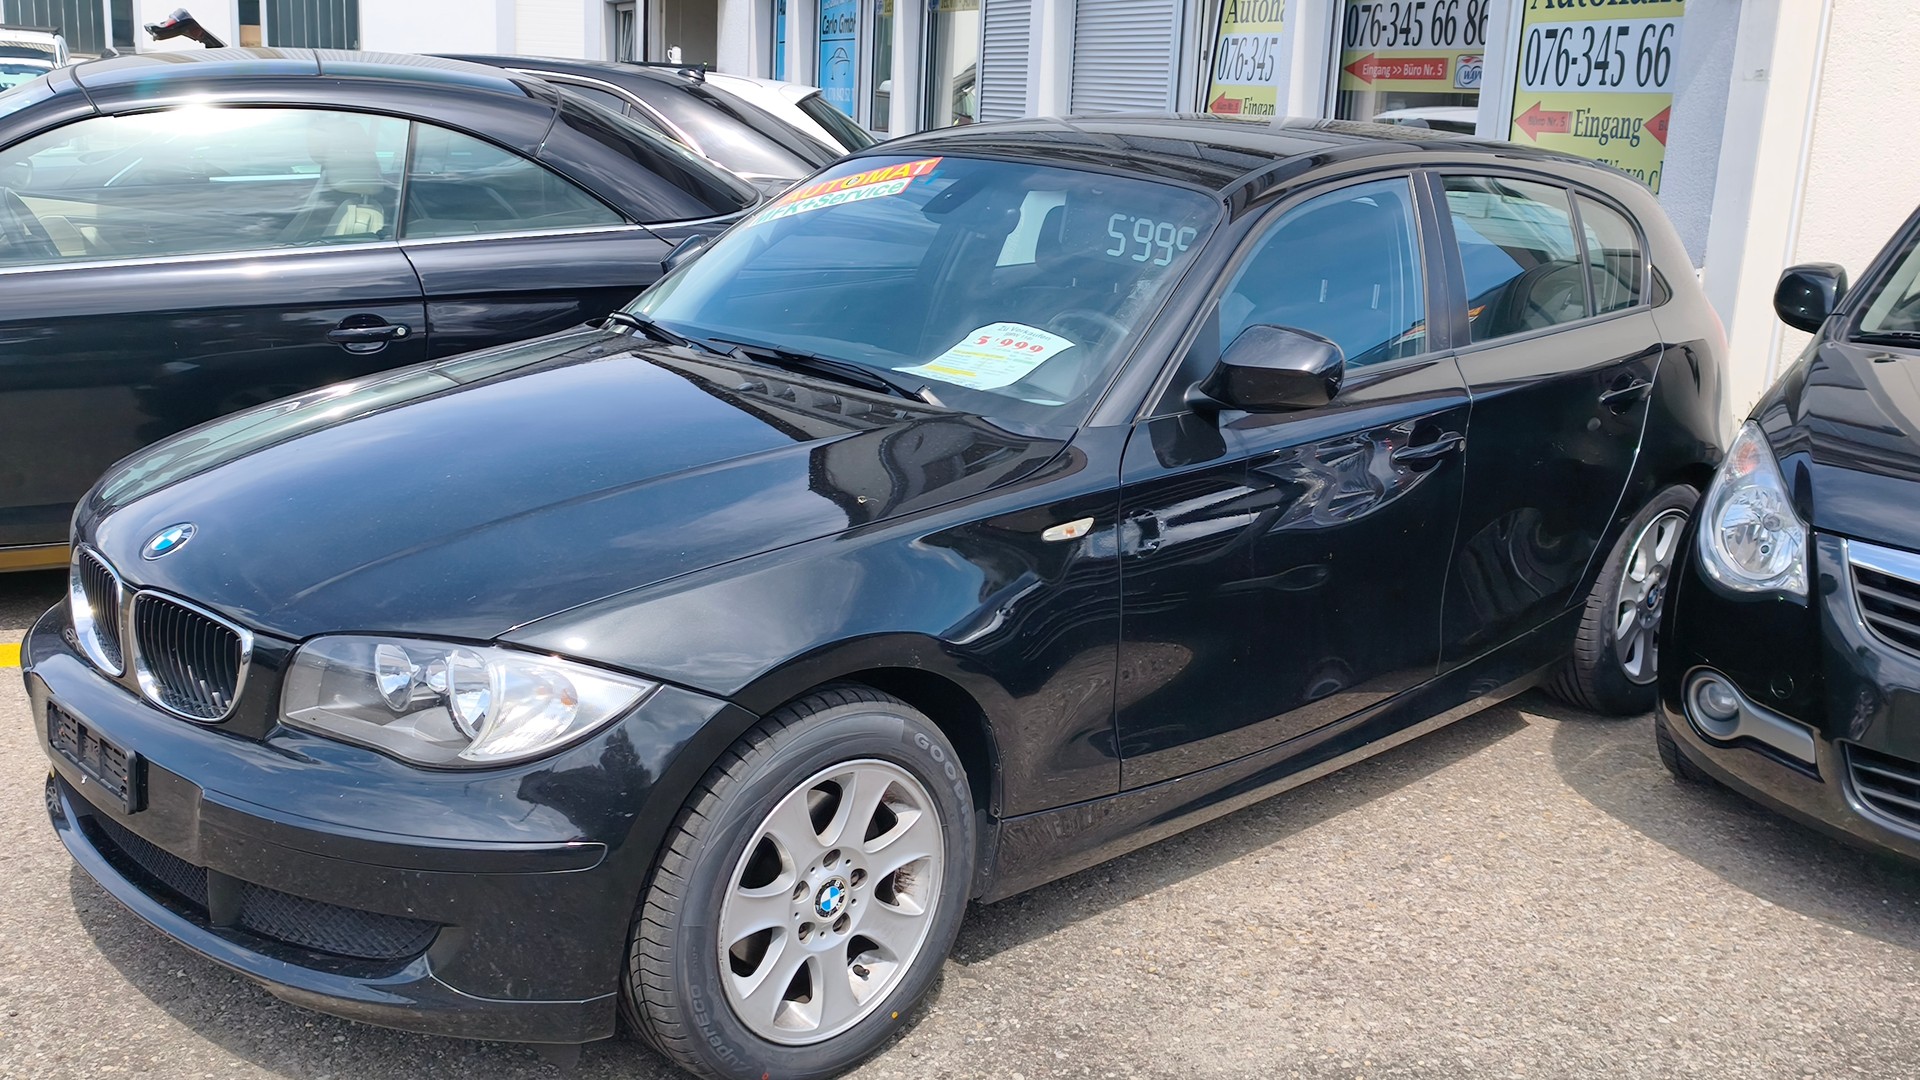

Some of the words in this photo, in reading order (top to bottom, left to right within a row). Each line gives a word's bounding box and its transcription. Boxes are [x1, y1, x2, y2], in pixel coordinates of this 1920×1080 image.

[1347, 1, 1425, 47] 076-345
[1431, 0, 1458, 46] 66
[1218, 37, 1279, 81] 076-345
[1362, 63, 1391, 78] Eingang
[1403, 63, 1422, 76] Büro
[1423, 64, 1435, 75] Nr.
[1437, 64, 1443, 75] 5
[1525, 25, 1630, 87] 076-345
[1636, 23, 1675, 88] 66
[1243, 97, 1276, 116] Eingan
[1573, 108, 1643, 148] Eingang
[786, 159, 936, 204] AUTOMAT
